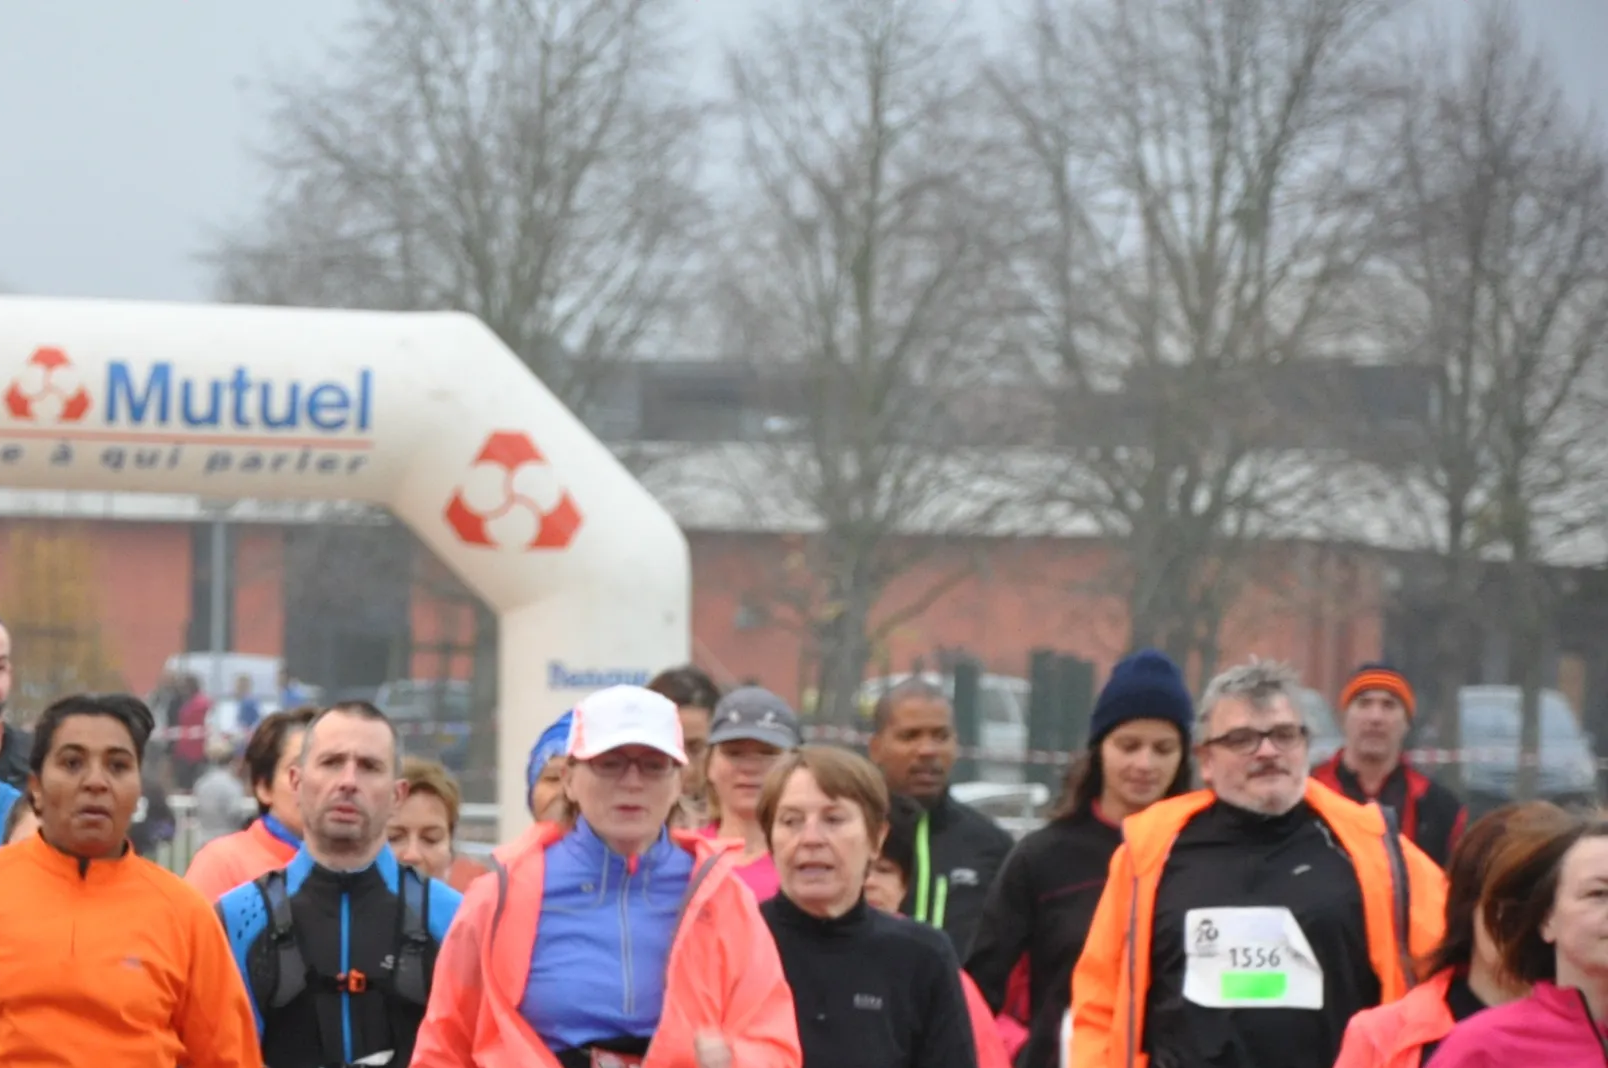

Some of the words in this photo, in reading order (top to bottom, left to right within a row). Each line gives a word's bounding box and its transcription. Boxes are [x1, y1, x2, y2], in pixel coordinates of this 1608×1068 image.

[105, 360, 373, 432] Mutuel
[101, 442, 182, 471] qui
[203, 445, 369, 475] parler
[1229, 946, 1281, 968] 1556
